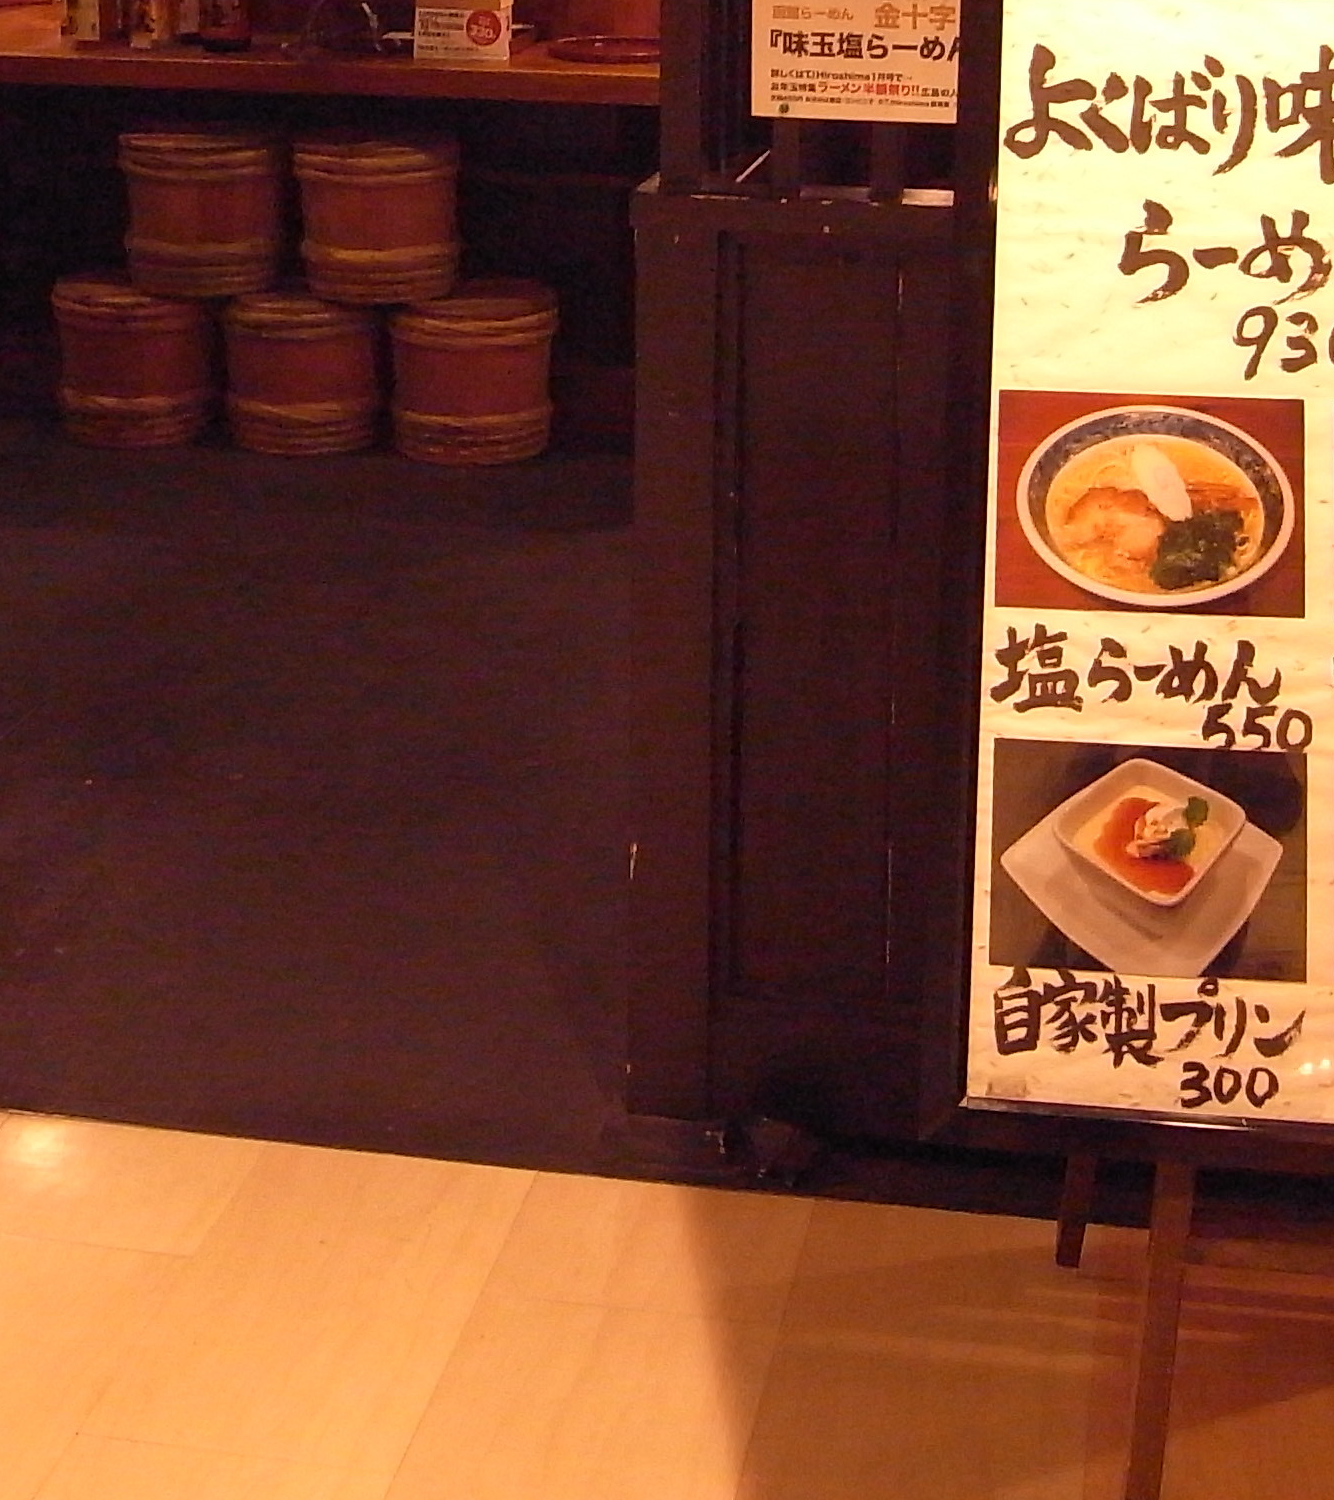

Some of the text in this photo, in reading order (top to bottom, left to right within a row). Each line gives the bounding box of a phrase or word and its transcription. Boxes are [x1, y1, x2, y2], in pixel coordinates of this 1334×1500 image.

[874, 1, 957, 31] 金十字
[990, 623, 1282, 713] 塩らーめん
[1201, 703, 1314, 752] 550
[993, 965, 1306, 1068] 自家製プリン
[1179, 1061, 1280, 1108] 300
